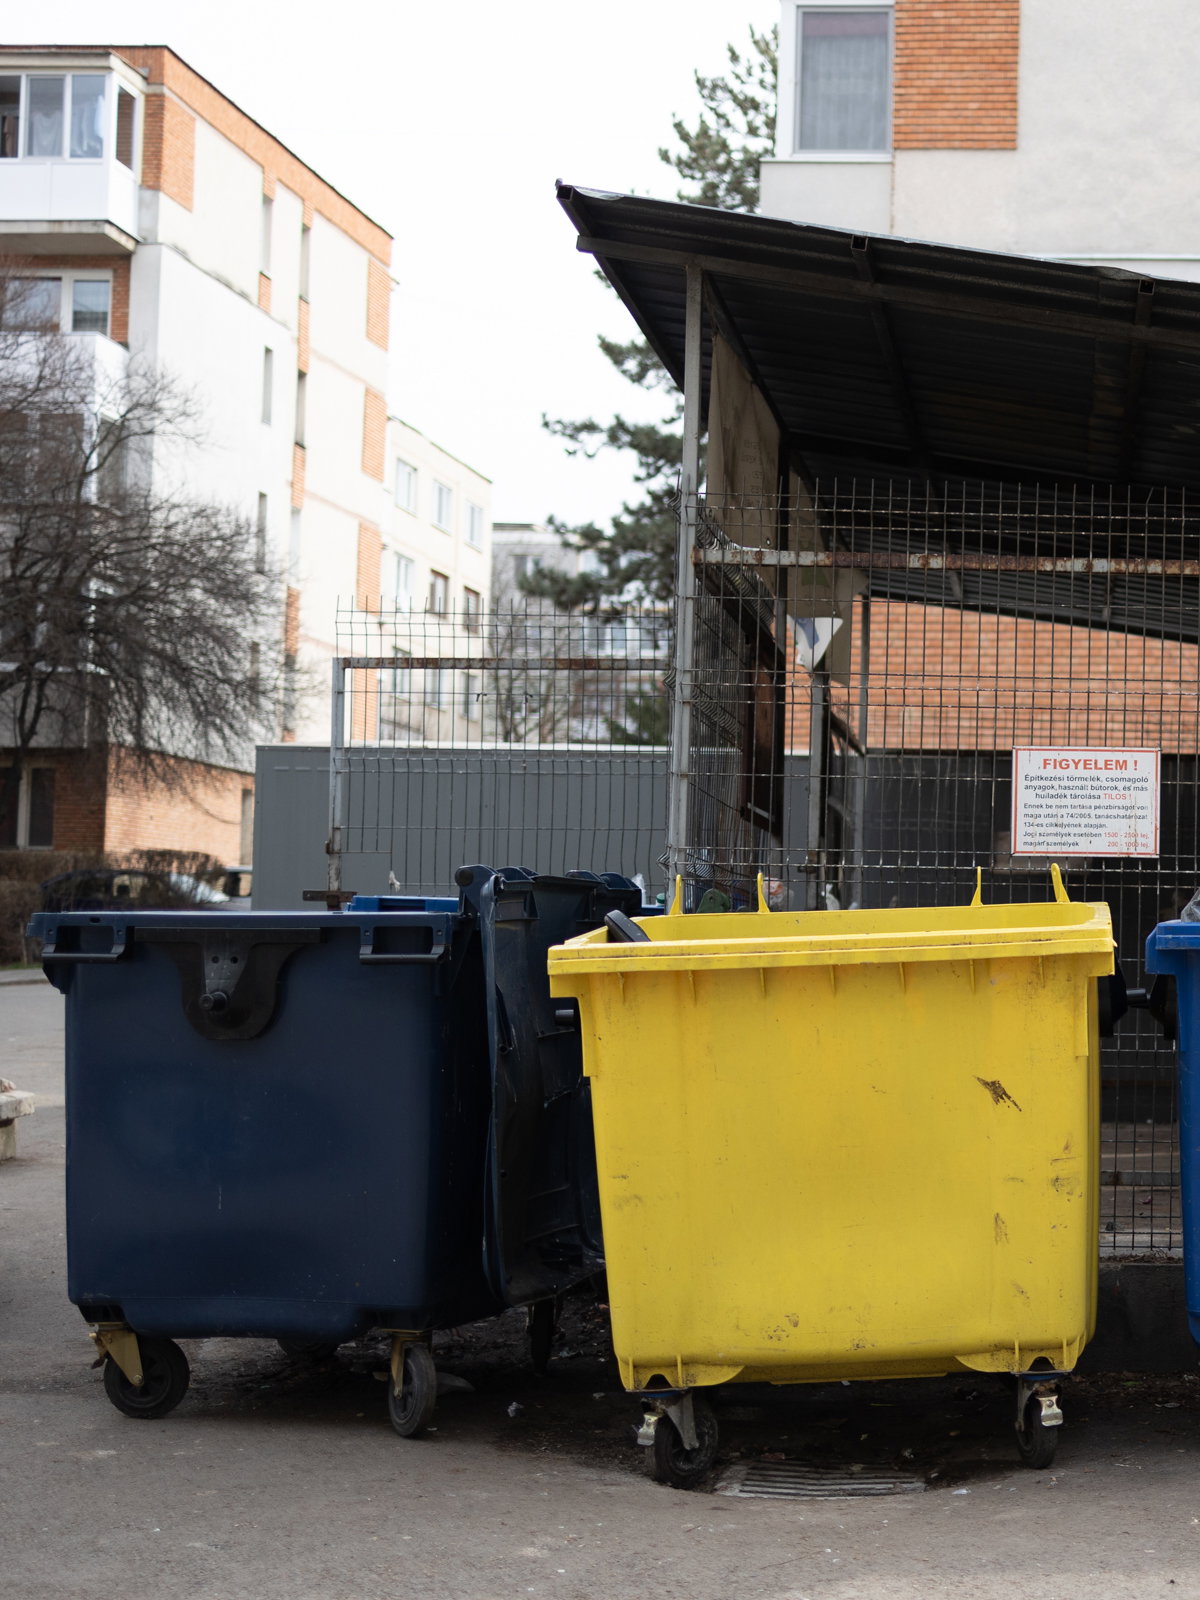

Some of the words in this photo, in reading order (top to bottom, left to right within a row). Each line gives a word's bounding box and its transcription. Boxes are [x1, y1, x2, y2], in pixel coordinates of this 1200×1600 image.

[1043, 758, 1127, 770] FIGYELEM
[1134, 760, 1138, 771] !
[1105, 776, 1149, 784] csomagoló
